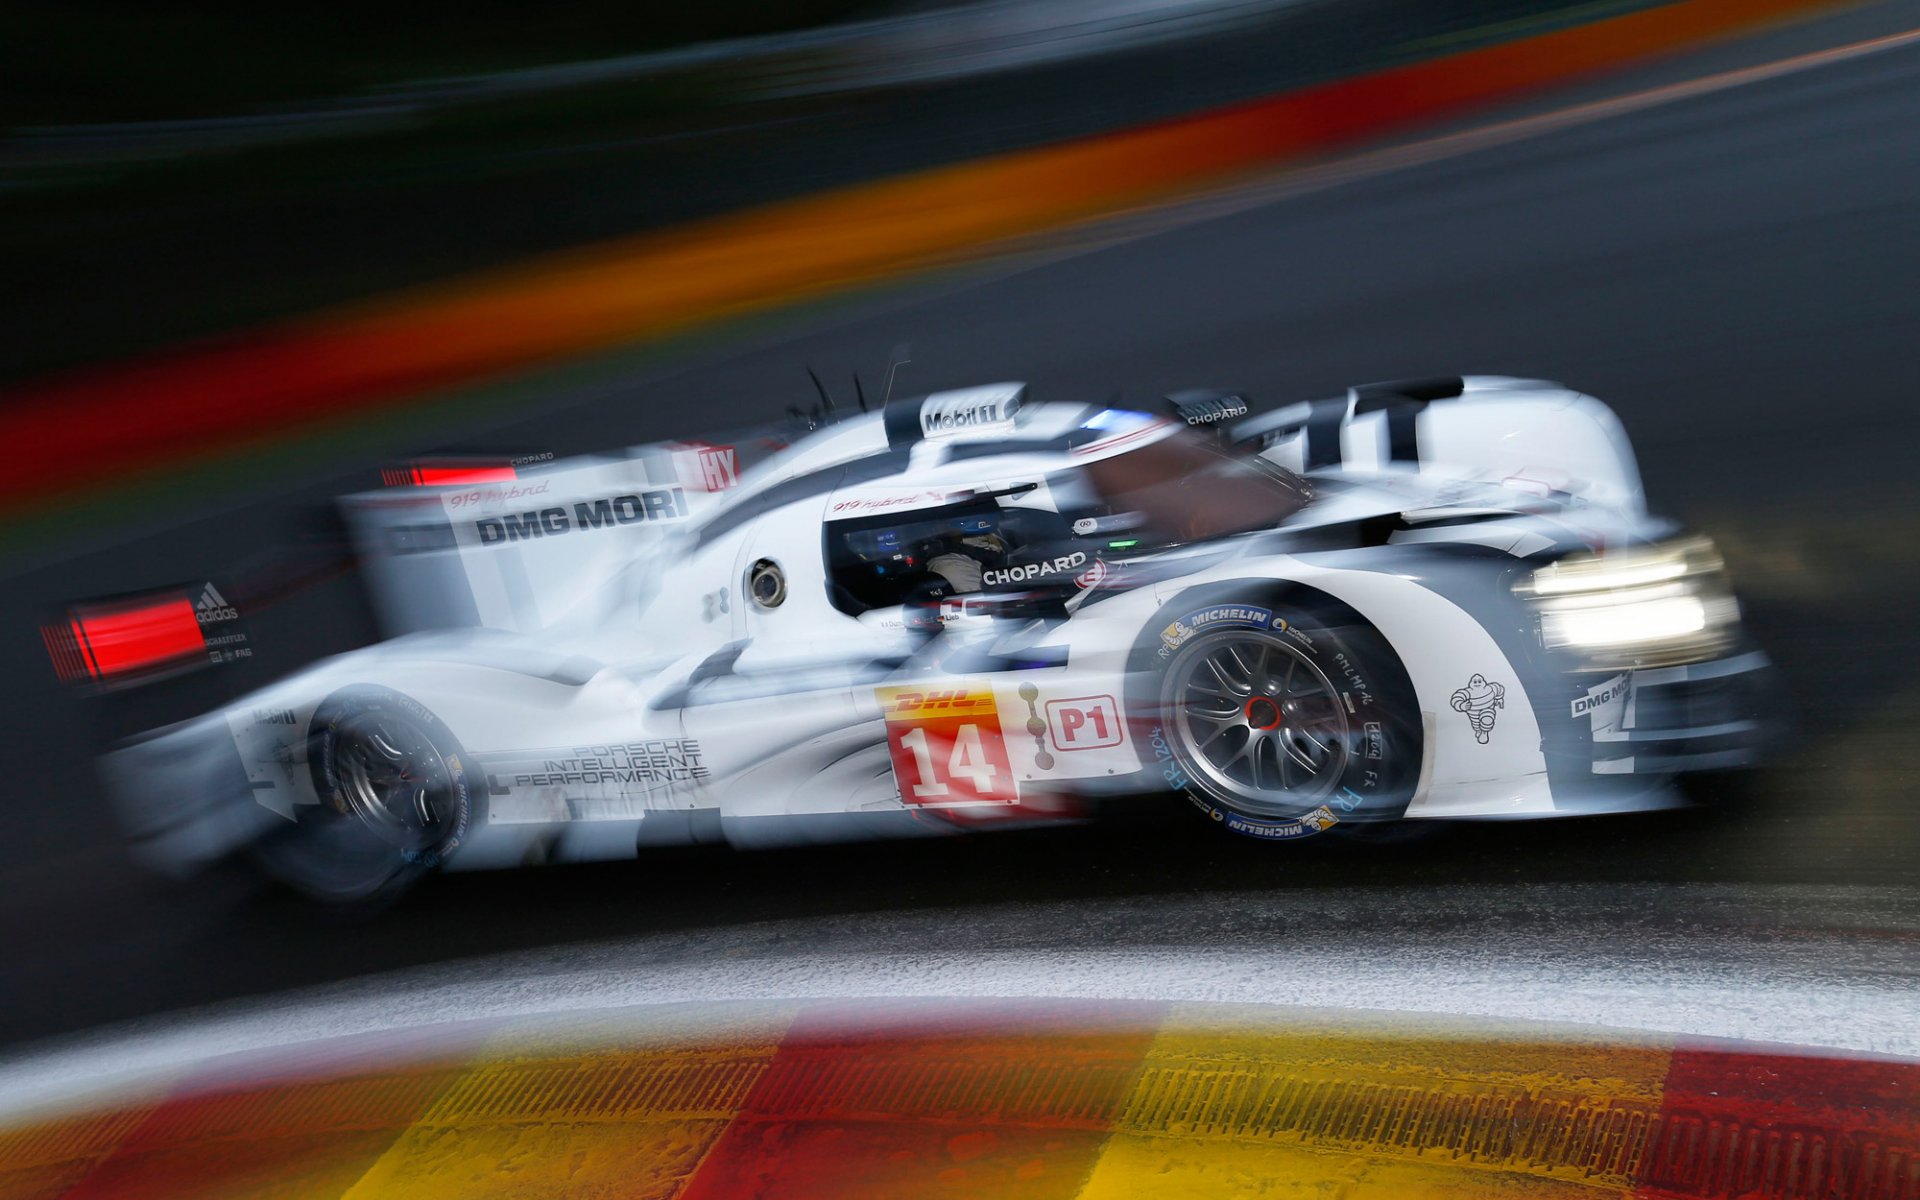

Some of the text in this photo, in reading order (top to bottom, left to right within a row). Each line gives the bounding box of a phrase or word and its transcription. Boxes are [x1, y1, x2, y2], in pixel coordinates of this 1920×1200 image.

[925, 407, 978, 432] Mobil
[1187, 406, 1248, 425] CHOPARD
[510, 452, 554, 466] CHOPARD
[700, 449, 738, 492] HY
[450, 479, 550, 509] 919 hybrid
[832, 494, 918, 513] 919 hybrid
[476, 487, 690, 547] DMG MORI
[983, 551, 1087, 586] CHOPARD
[196, 607, 239, 623] adidas
[945, 613, 960, 621] Lieb
[1192, 609, 1267, 627] MICHELIN
[235, 648, 253, 658] FAG
[894, 690, 978, 712] DHL
[1575, 691, 1611, 713] DMG
[1059, 704, 1108, 742] P1
[573, 739, 701, 757] PORSCHE
[544, 753, 702, 773] INTELLIGENT
[900, 723, 997, 797] 14
[515, 766, 712, 788] PERFORMANCE
[456, 783, 469, 837] MICHELIN
[1228, 820, 1303, 837] MICHELIN
